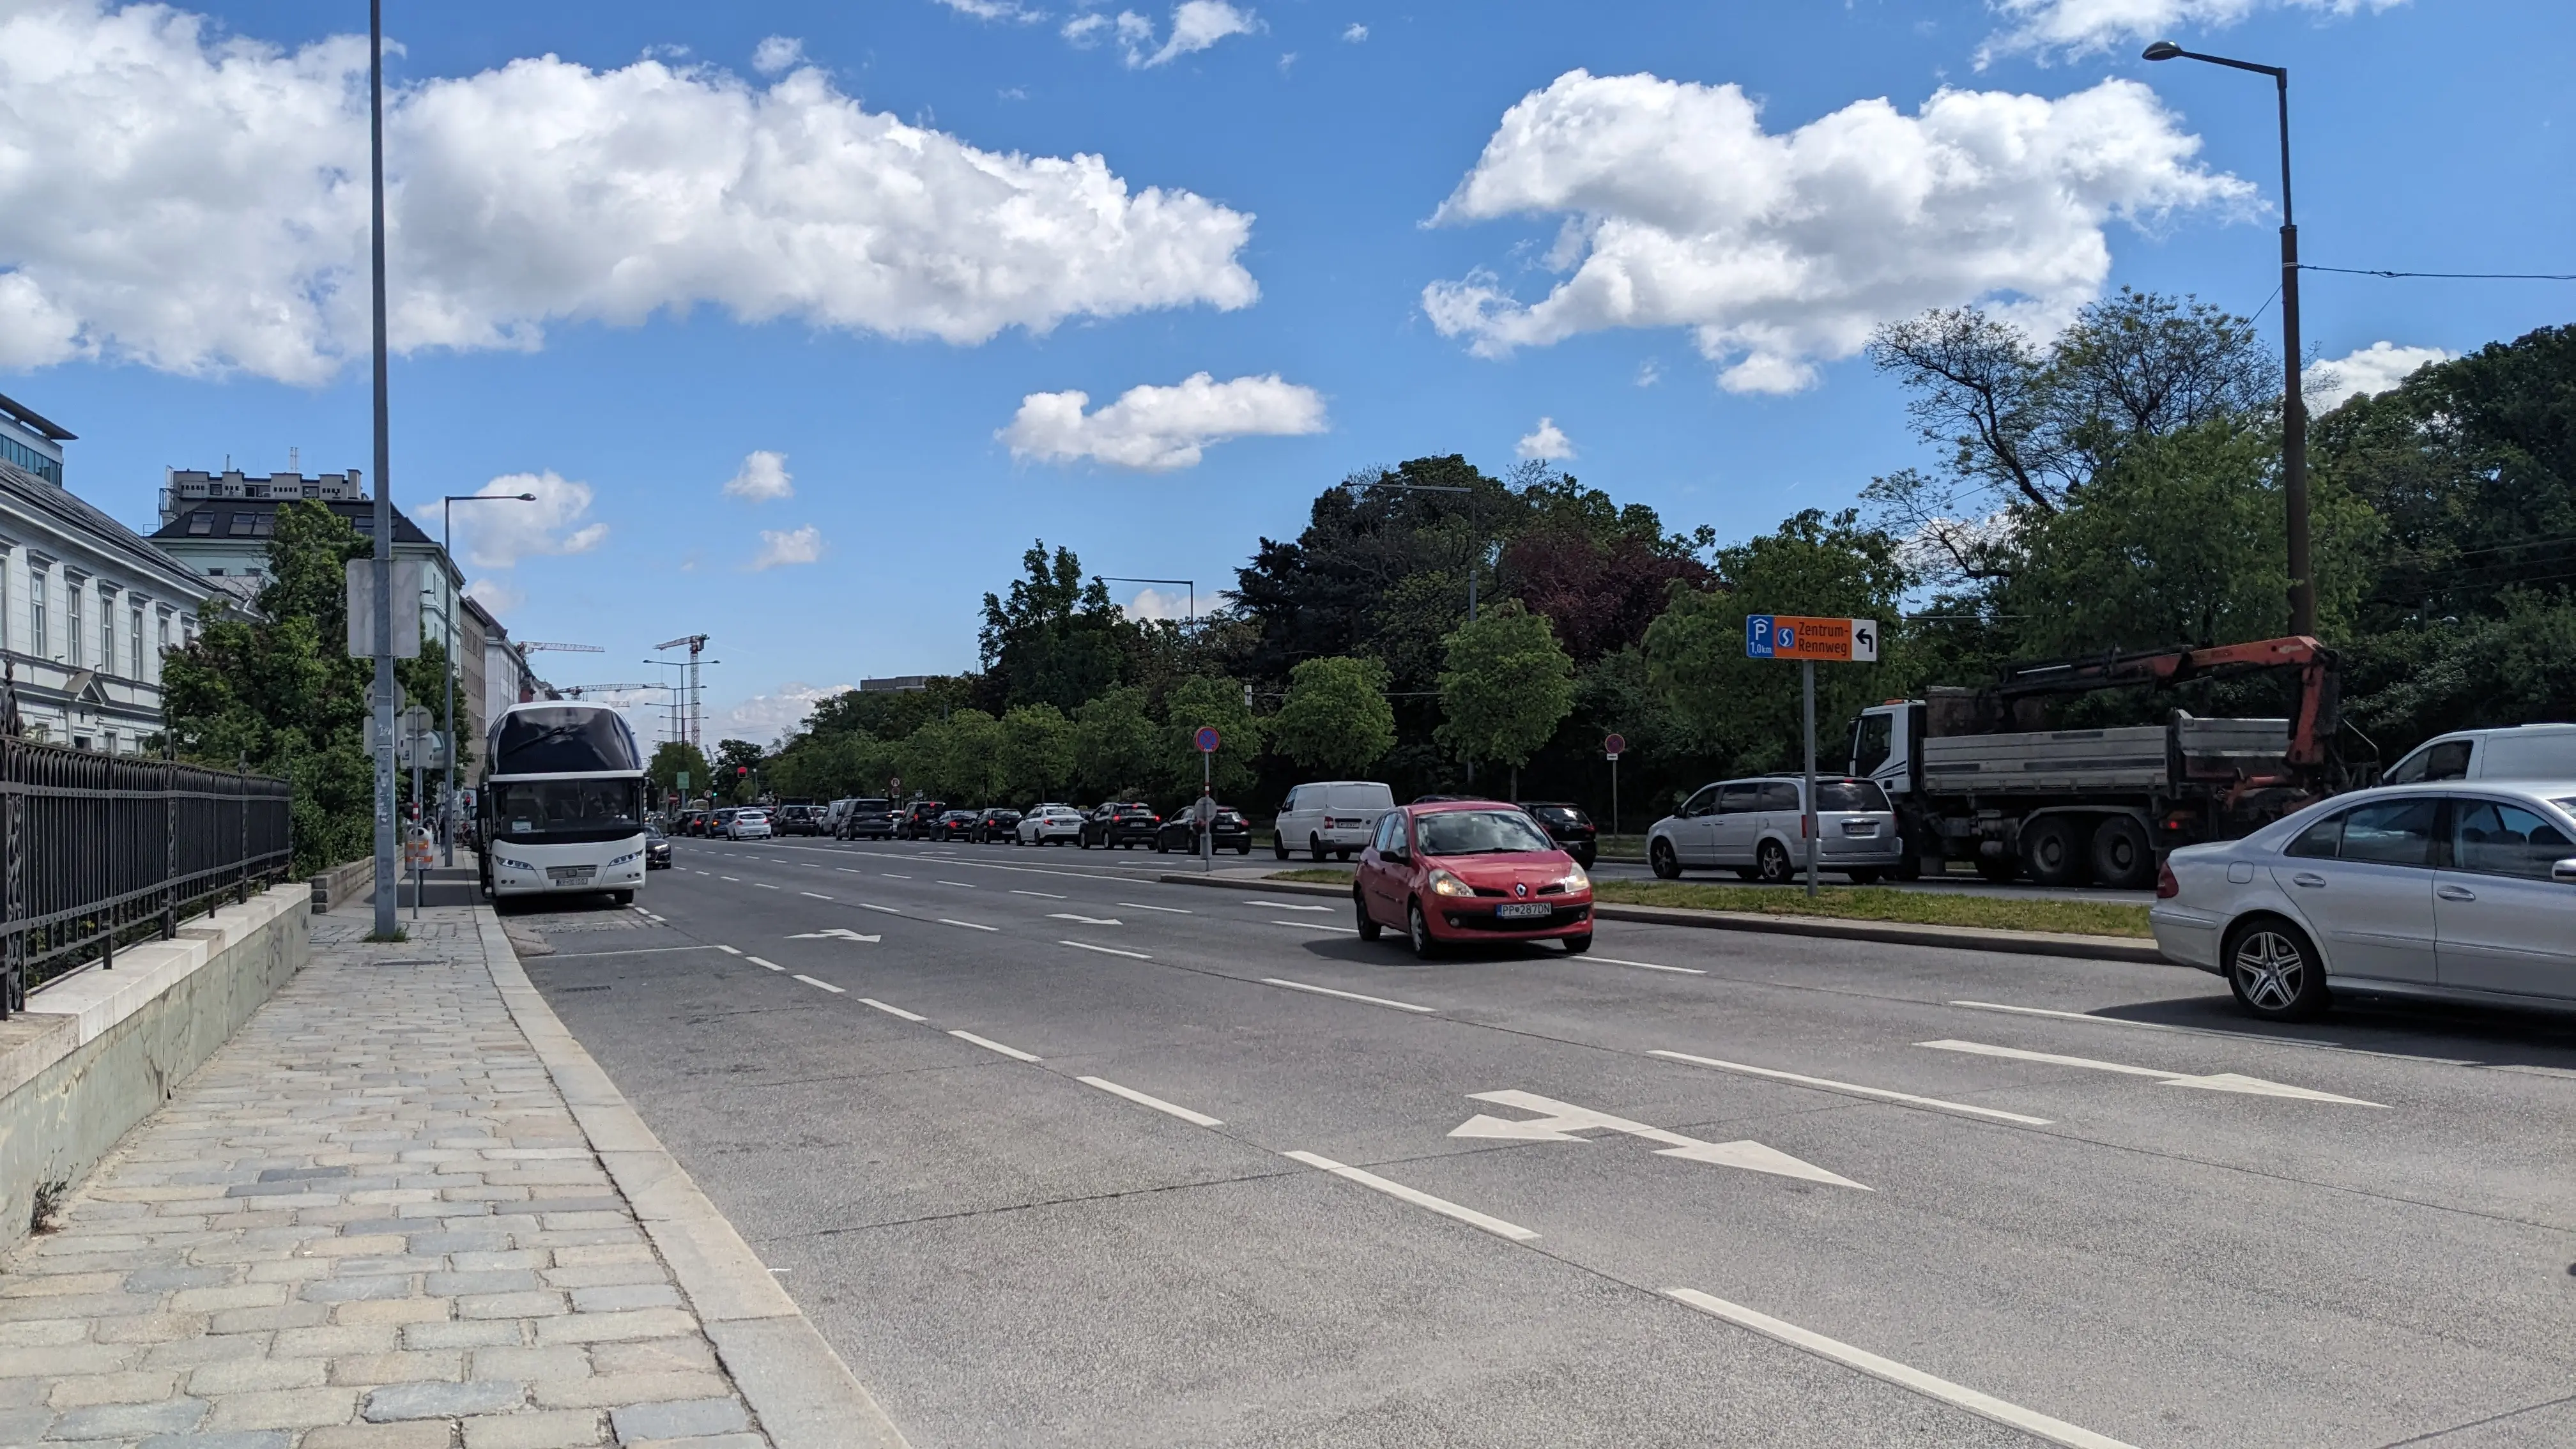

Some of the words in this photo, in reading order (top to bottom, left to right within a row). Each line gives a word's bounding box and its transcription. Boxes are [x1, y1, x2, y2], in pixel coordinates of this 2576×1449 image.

[1756, 624, 1767, 640] P
[1798, 622, 1849, 636] Zentrum-
[1798, 639, 1847, 656] Rennweg
